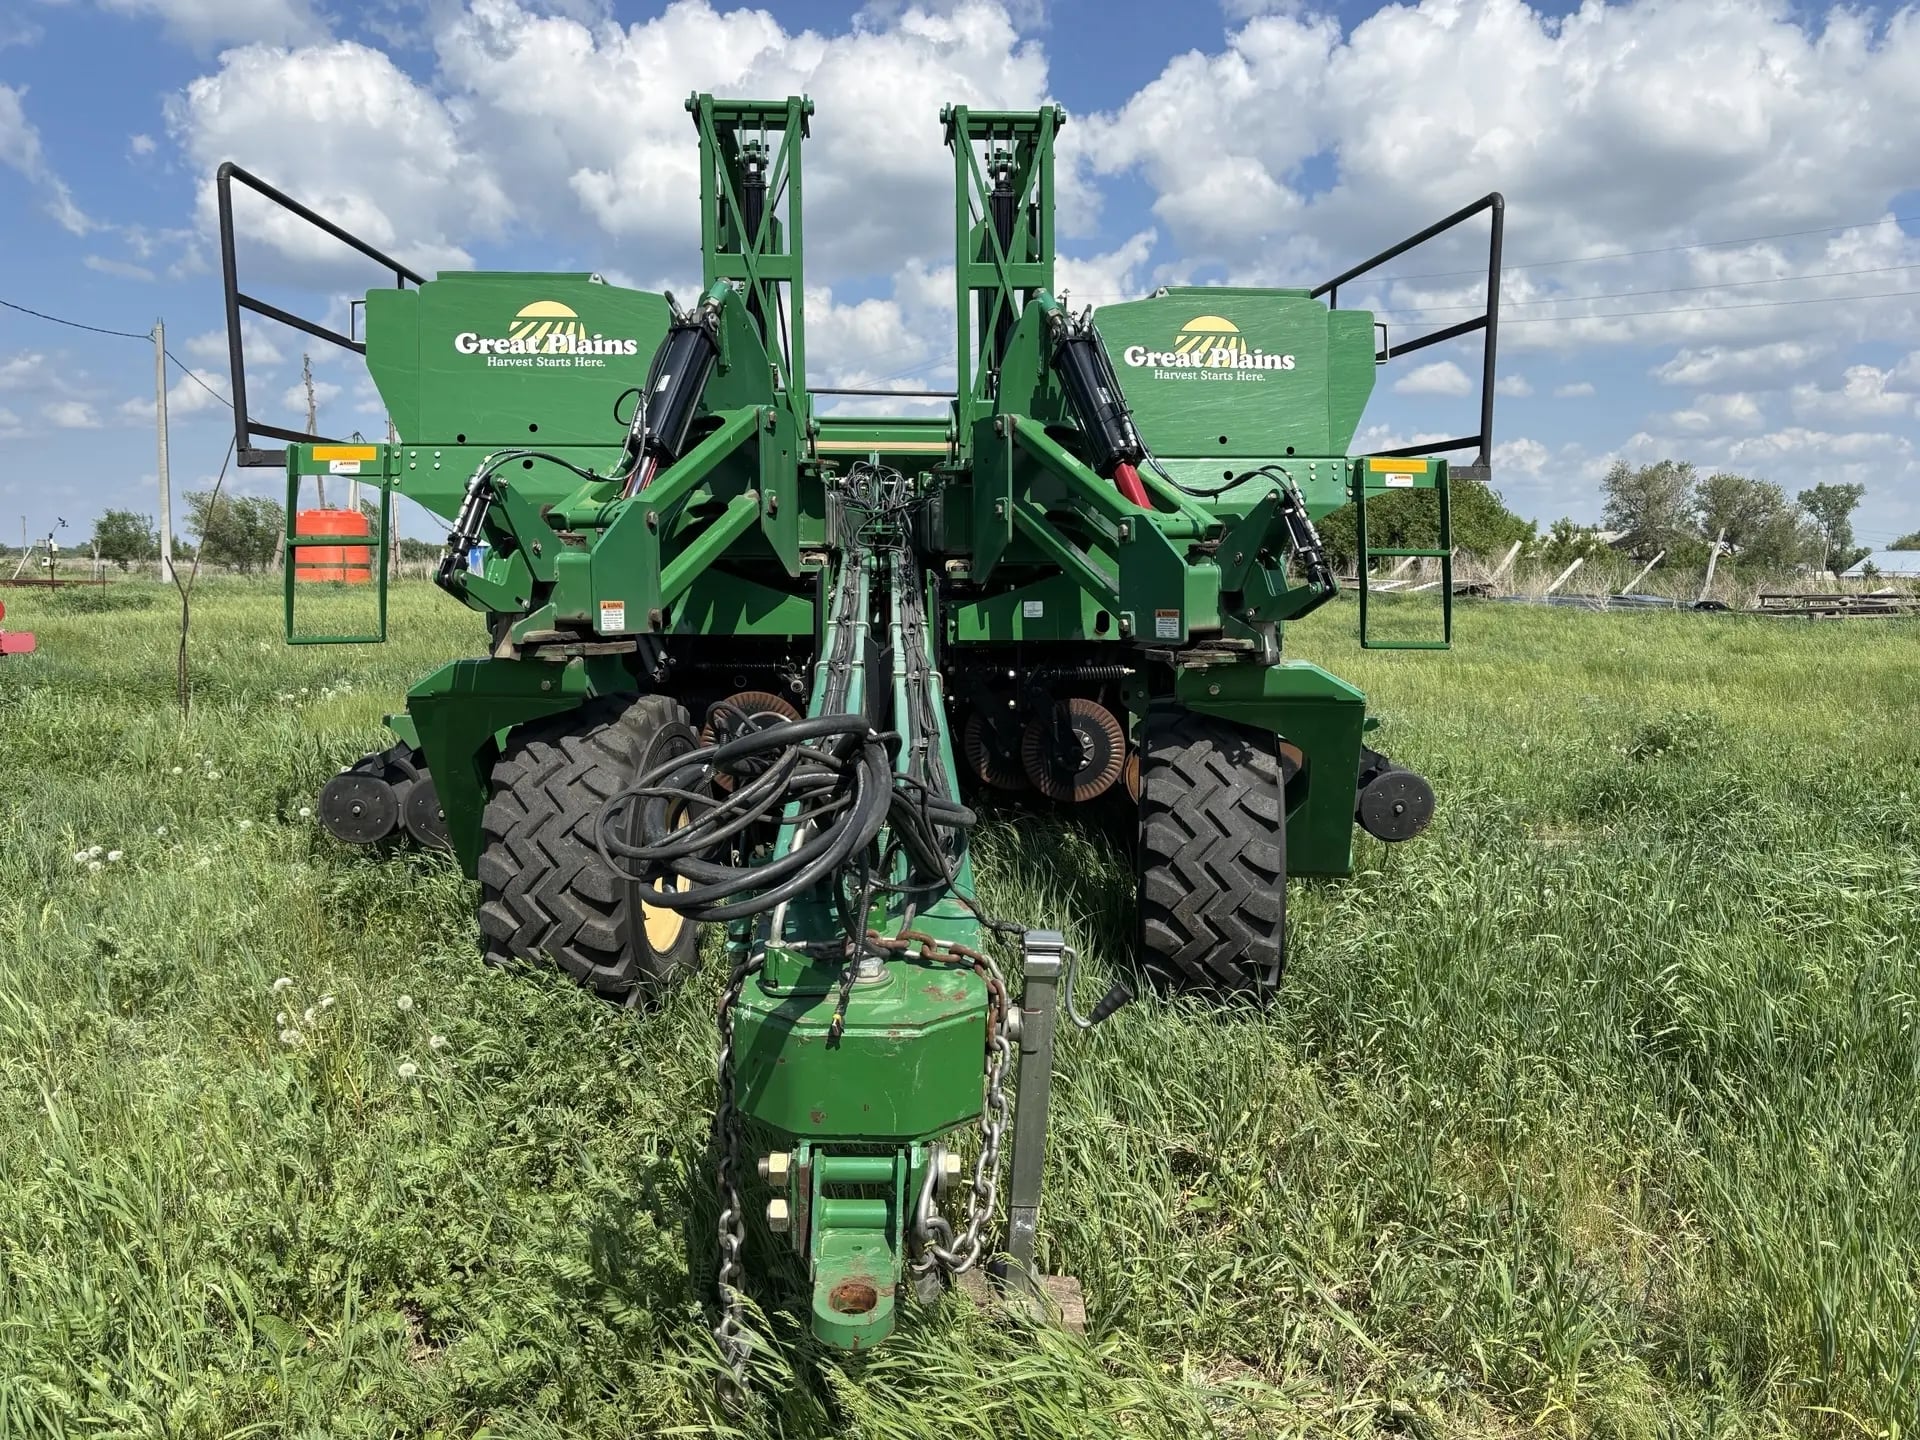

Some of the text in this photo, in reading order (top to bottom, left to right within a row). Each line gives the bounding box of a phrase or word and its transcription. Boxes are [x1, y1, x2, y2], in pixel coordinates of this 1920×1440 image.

[454, 332, 638, 355] Great Plains
[487, 356, 606, 367] Harvest Starts Here.
[1123, 345, 1296, 370] Great Plains
[1154, 369, 1266, 381] Harvest Starts Here.
